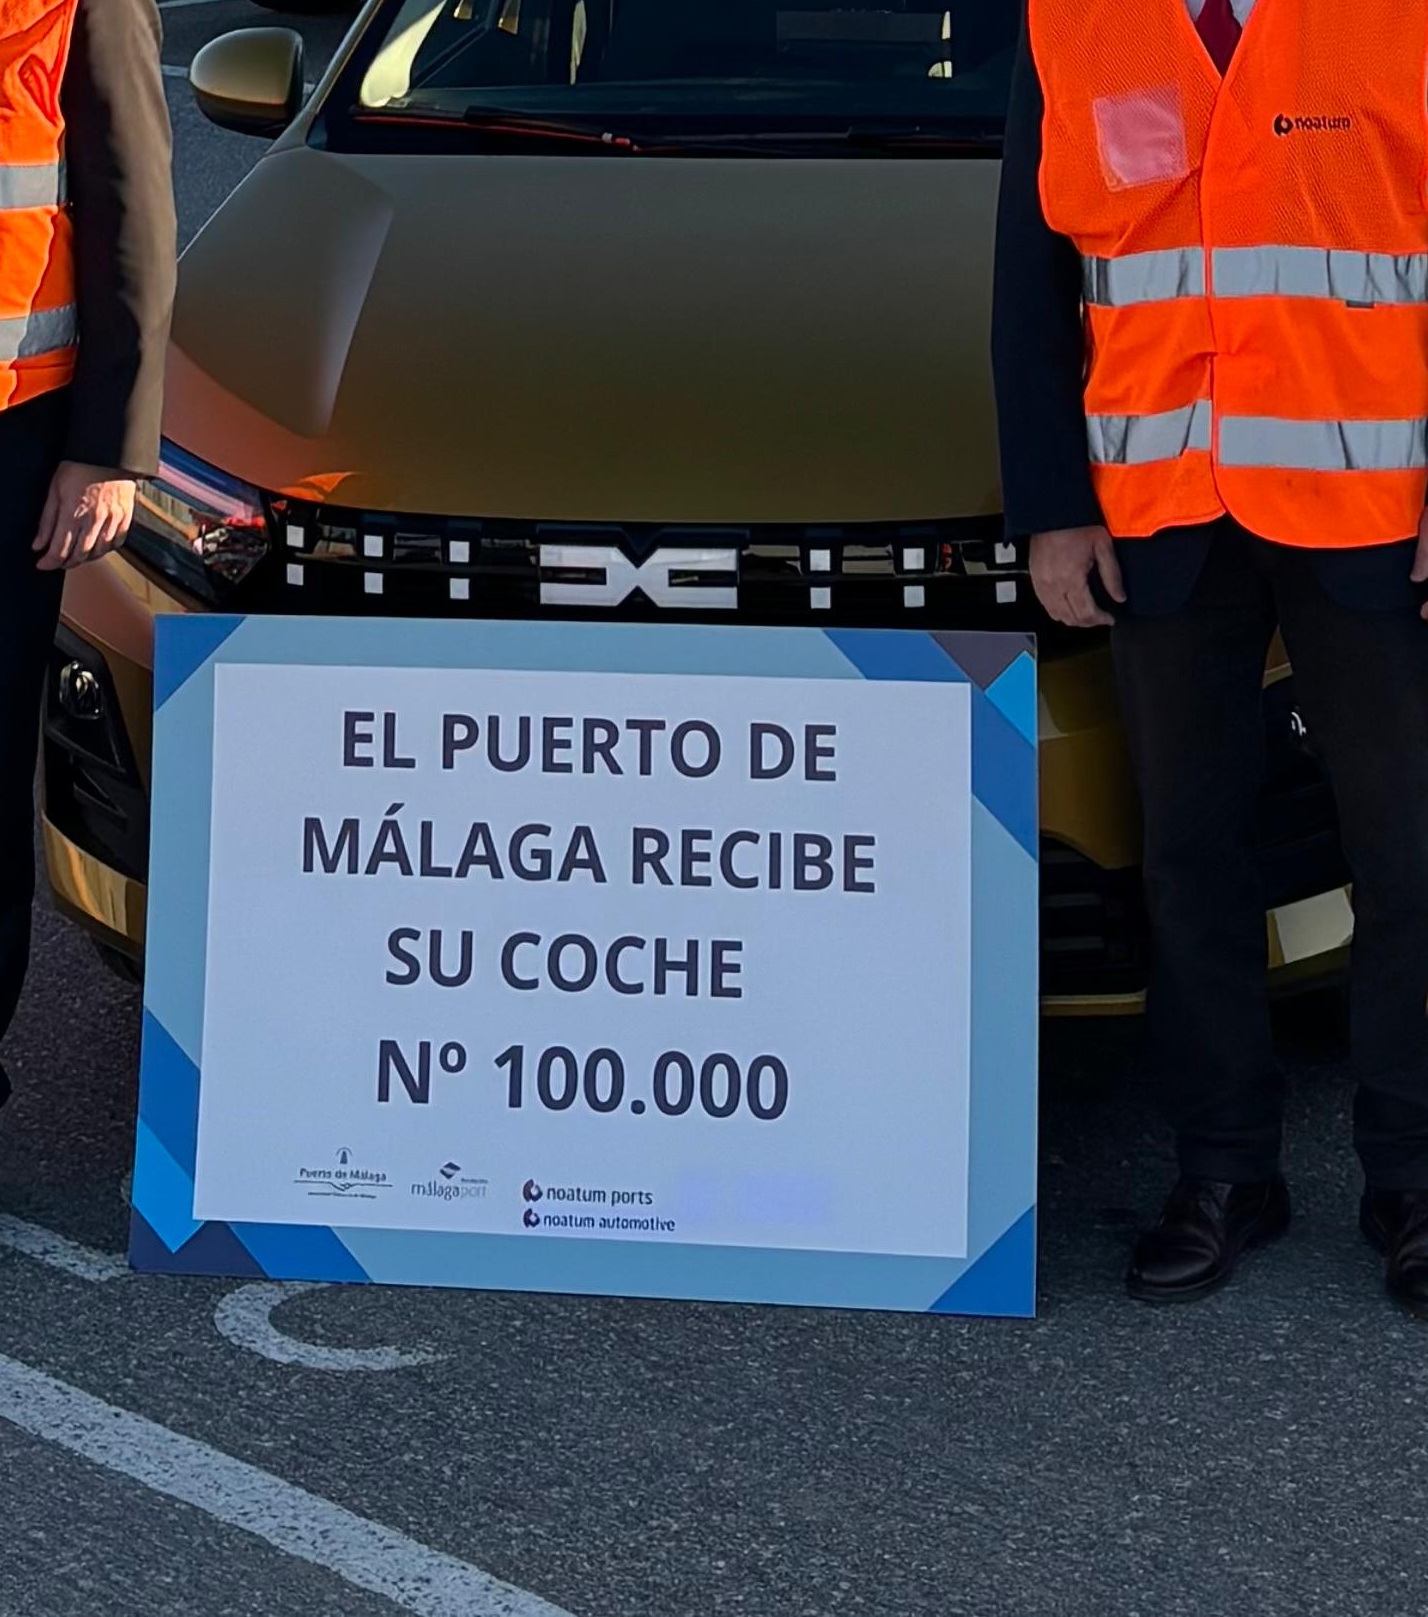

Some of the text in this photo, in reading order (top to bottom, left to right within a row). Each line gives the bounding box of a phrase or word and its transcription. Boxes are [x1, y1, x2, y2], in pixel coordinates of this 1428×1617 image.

[1294, 116, 1351, 131] noatum
[342, 710, 838, 782] EL PUERTO DE
[302, 802, 877, 894] MÁLAGA RECIBE
[384, 927, 745, 999] SU COCHE
[377, 1039, 789, 1120] Nº 100.000
[300, 1168, 332, 1179] Puerto
[546, 1187, 653, 1207] noatum ports
[544, 1214, 676, 1232] noatum automotive
